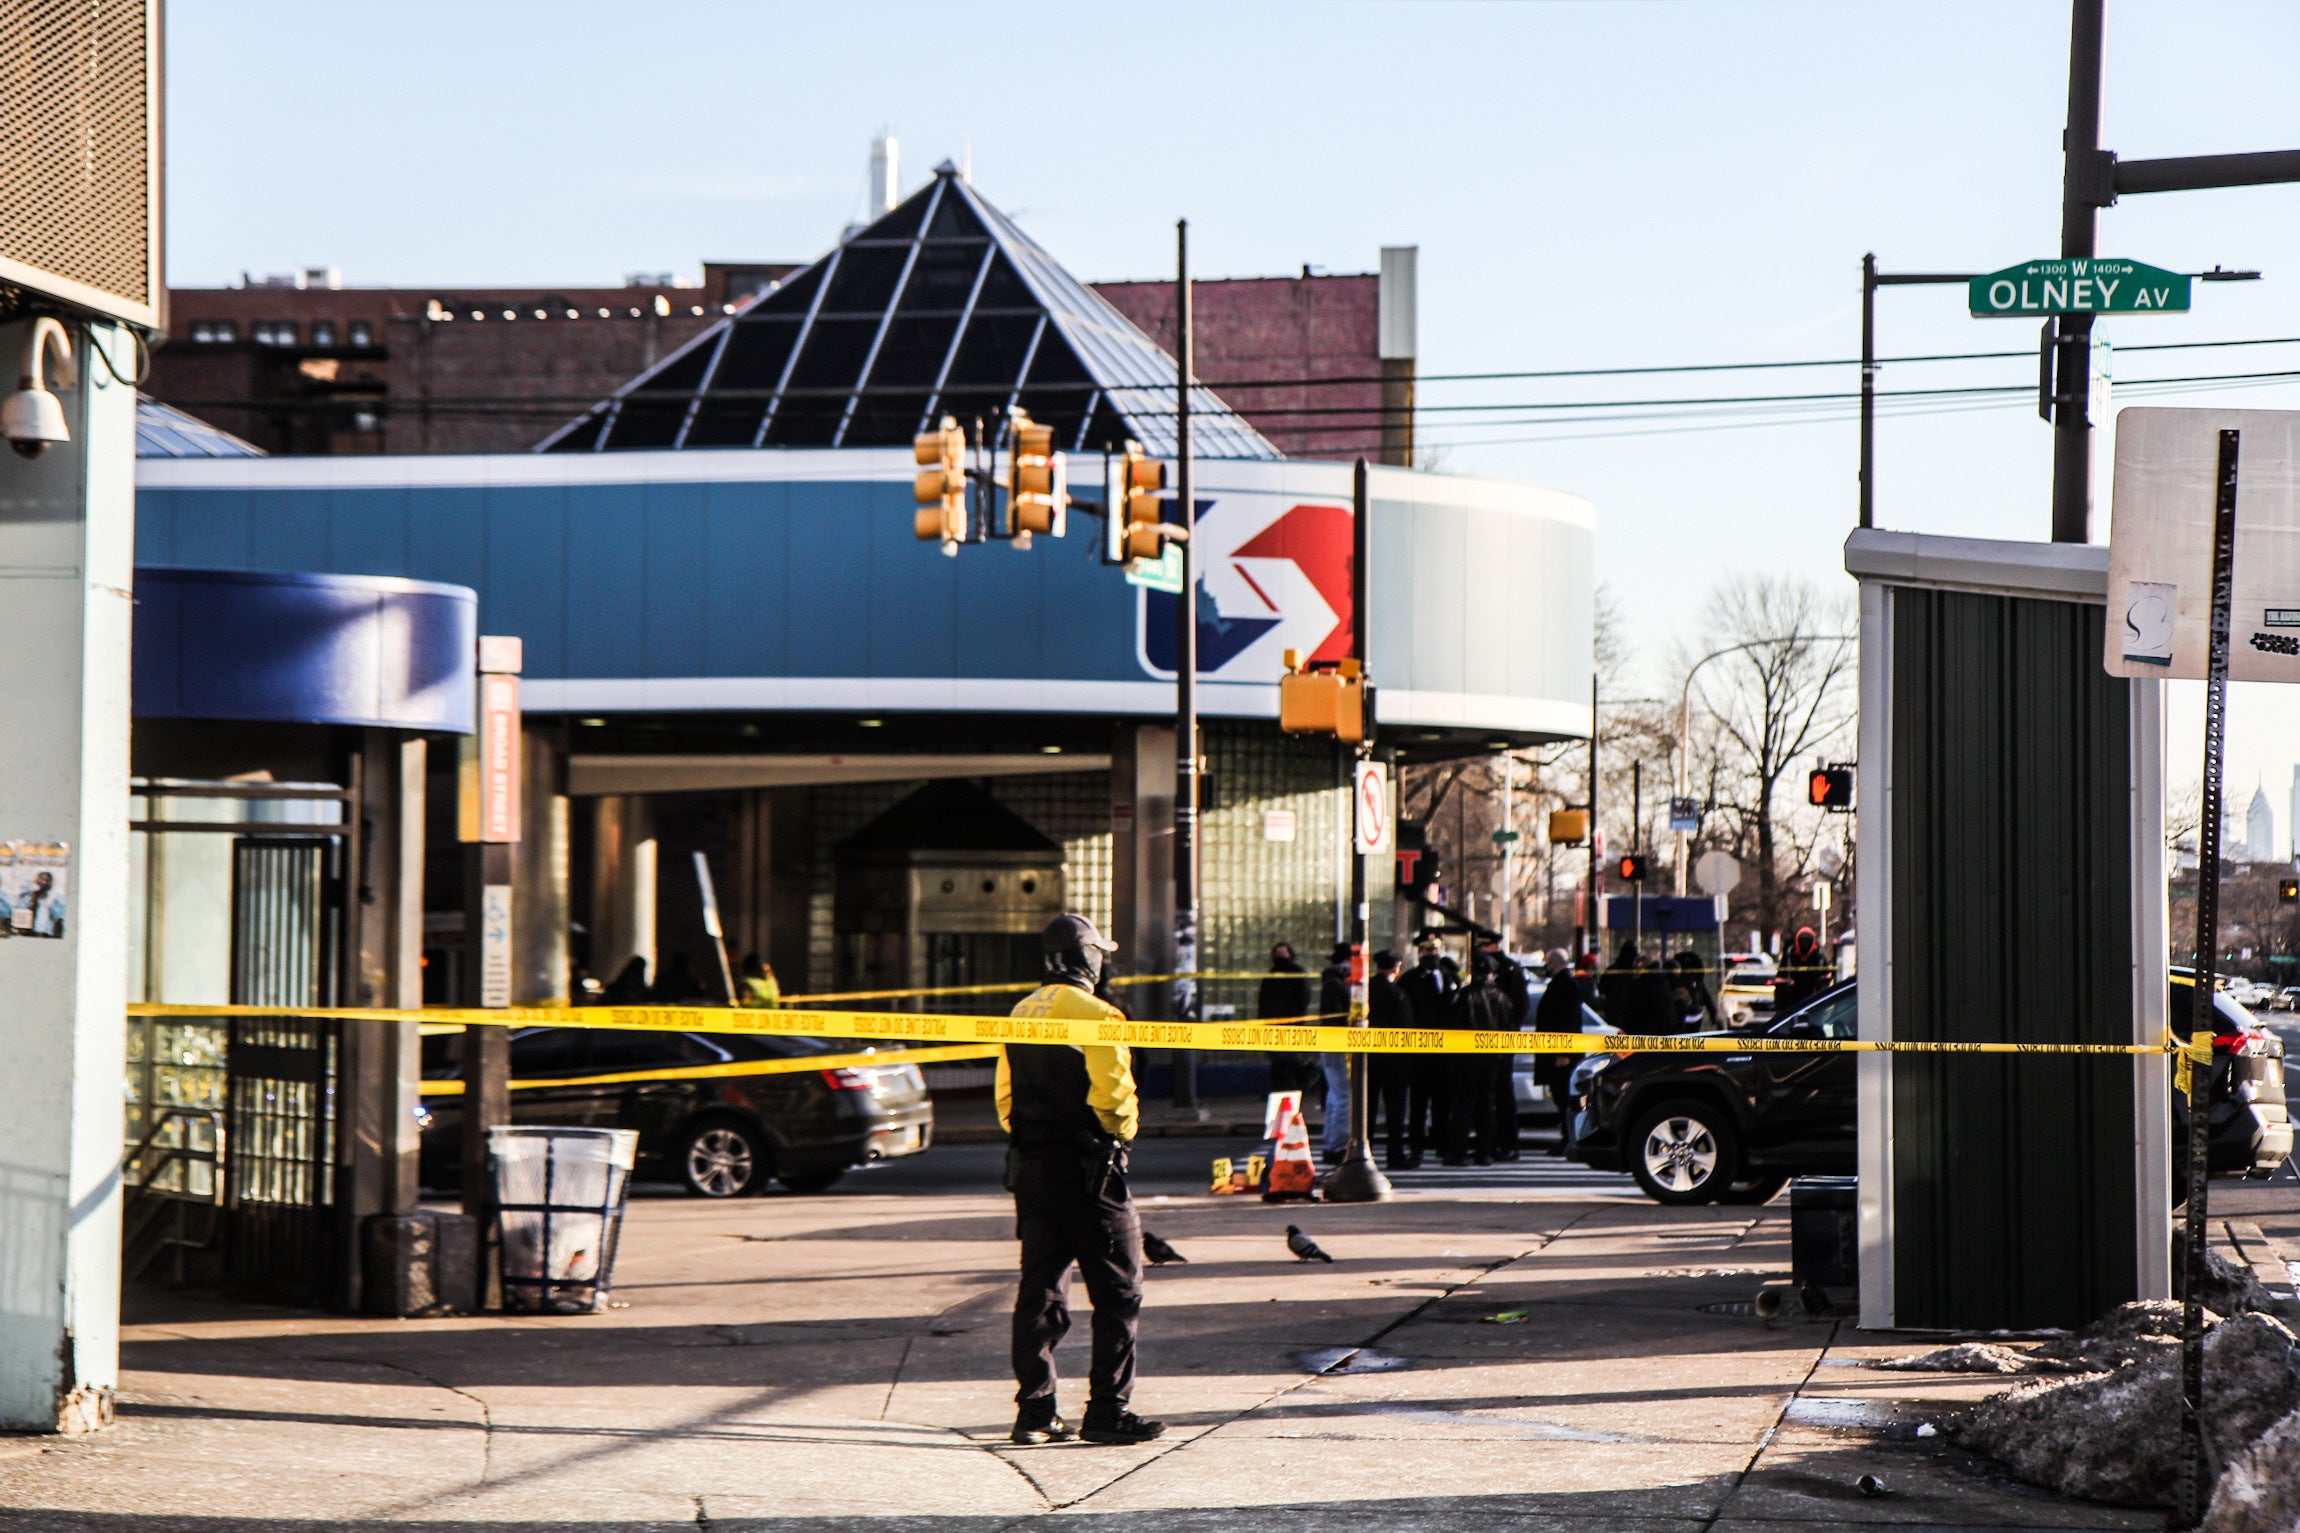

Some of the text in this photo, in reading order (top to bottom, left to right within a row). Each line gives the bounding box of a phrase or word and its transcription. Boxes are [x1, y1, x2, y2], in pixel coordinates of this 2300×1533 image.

[2040, 260, 2120, 277] 1300 W 1400
[1989, 279, 2170, 310] OLNEY AV
[976, 1021, 1068, 1039] POLICE LINE DO NOT CROSS
[1098, 1025, 1192, 1042] POLICE LINE DO NOT CROSS
[1222, 1028, 1317, 1045] POLICE LINE DO NOT CROSS
[1348, 1031, 1444, 1047] POLICE LINE DO NOT CROSS
[1475, 1033, 1573, 1048] POLICE LINE DO NOT CROSS
[1605, 1036, 1704, 1049] POLICE LINE DO NOT CROSS
